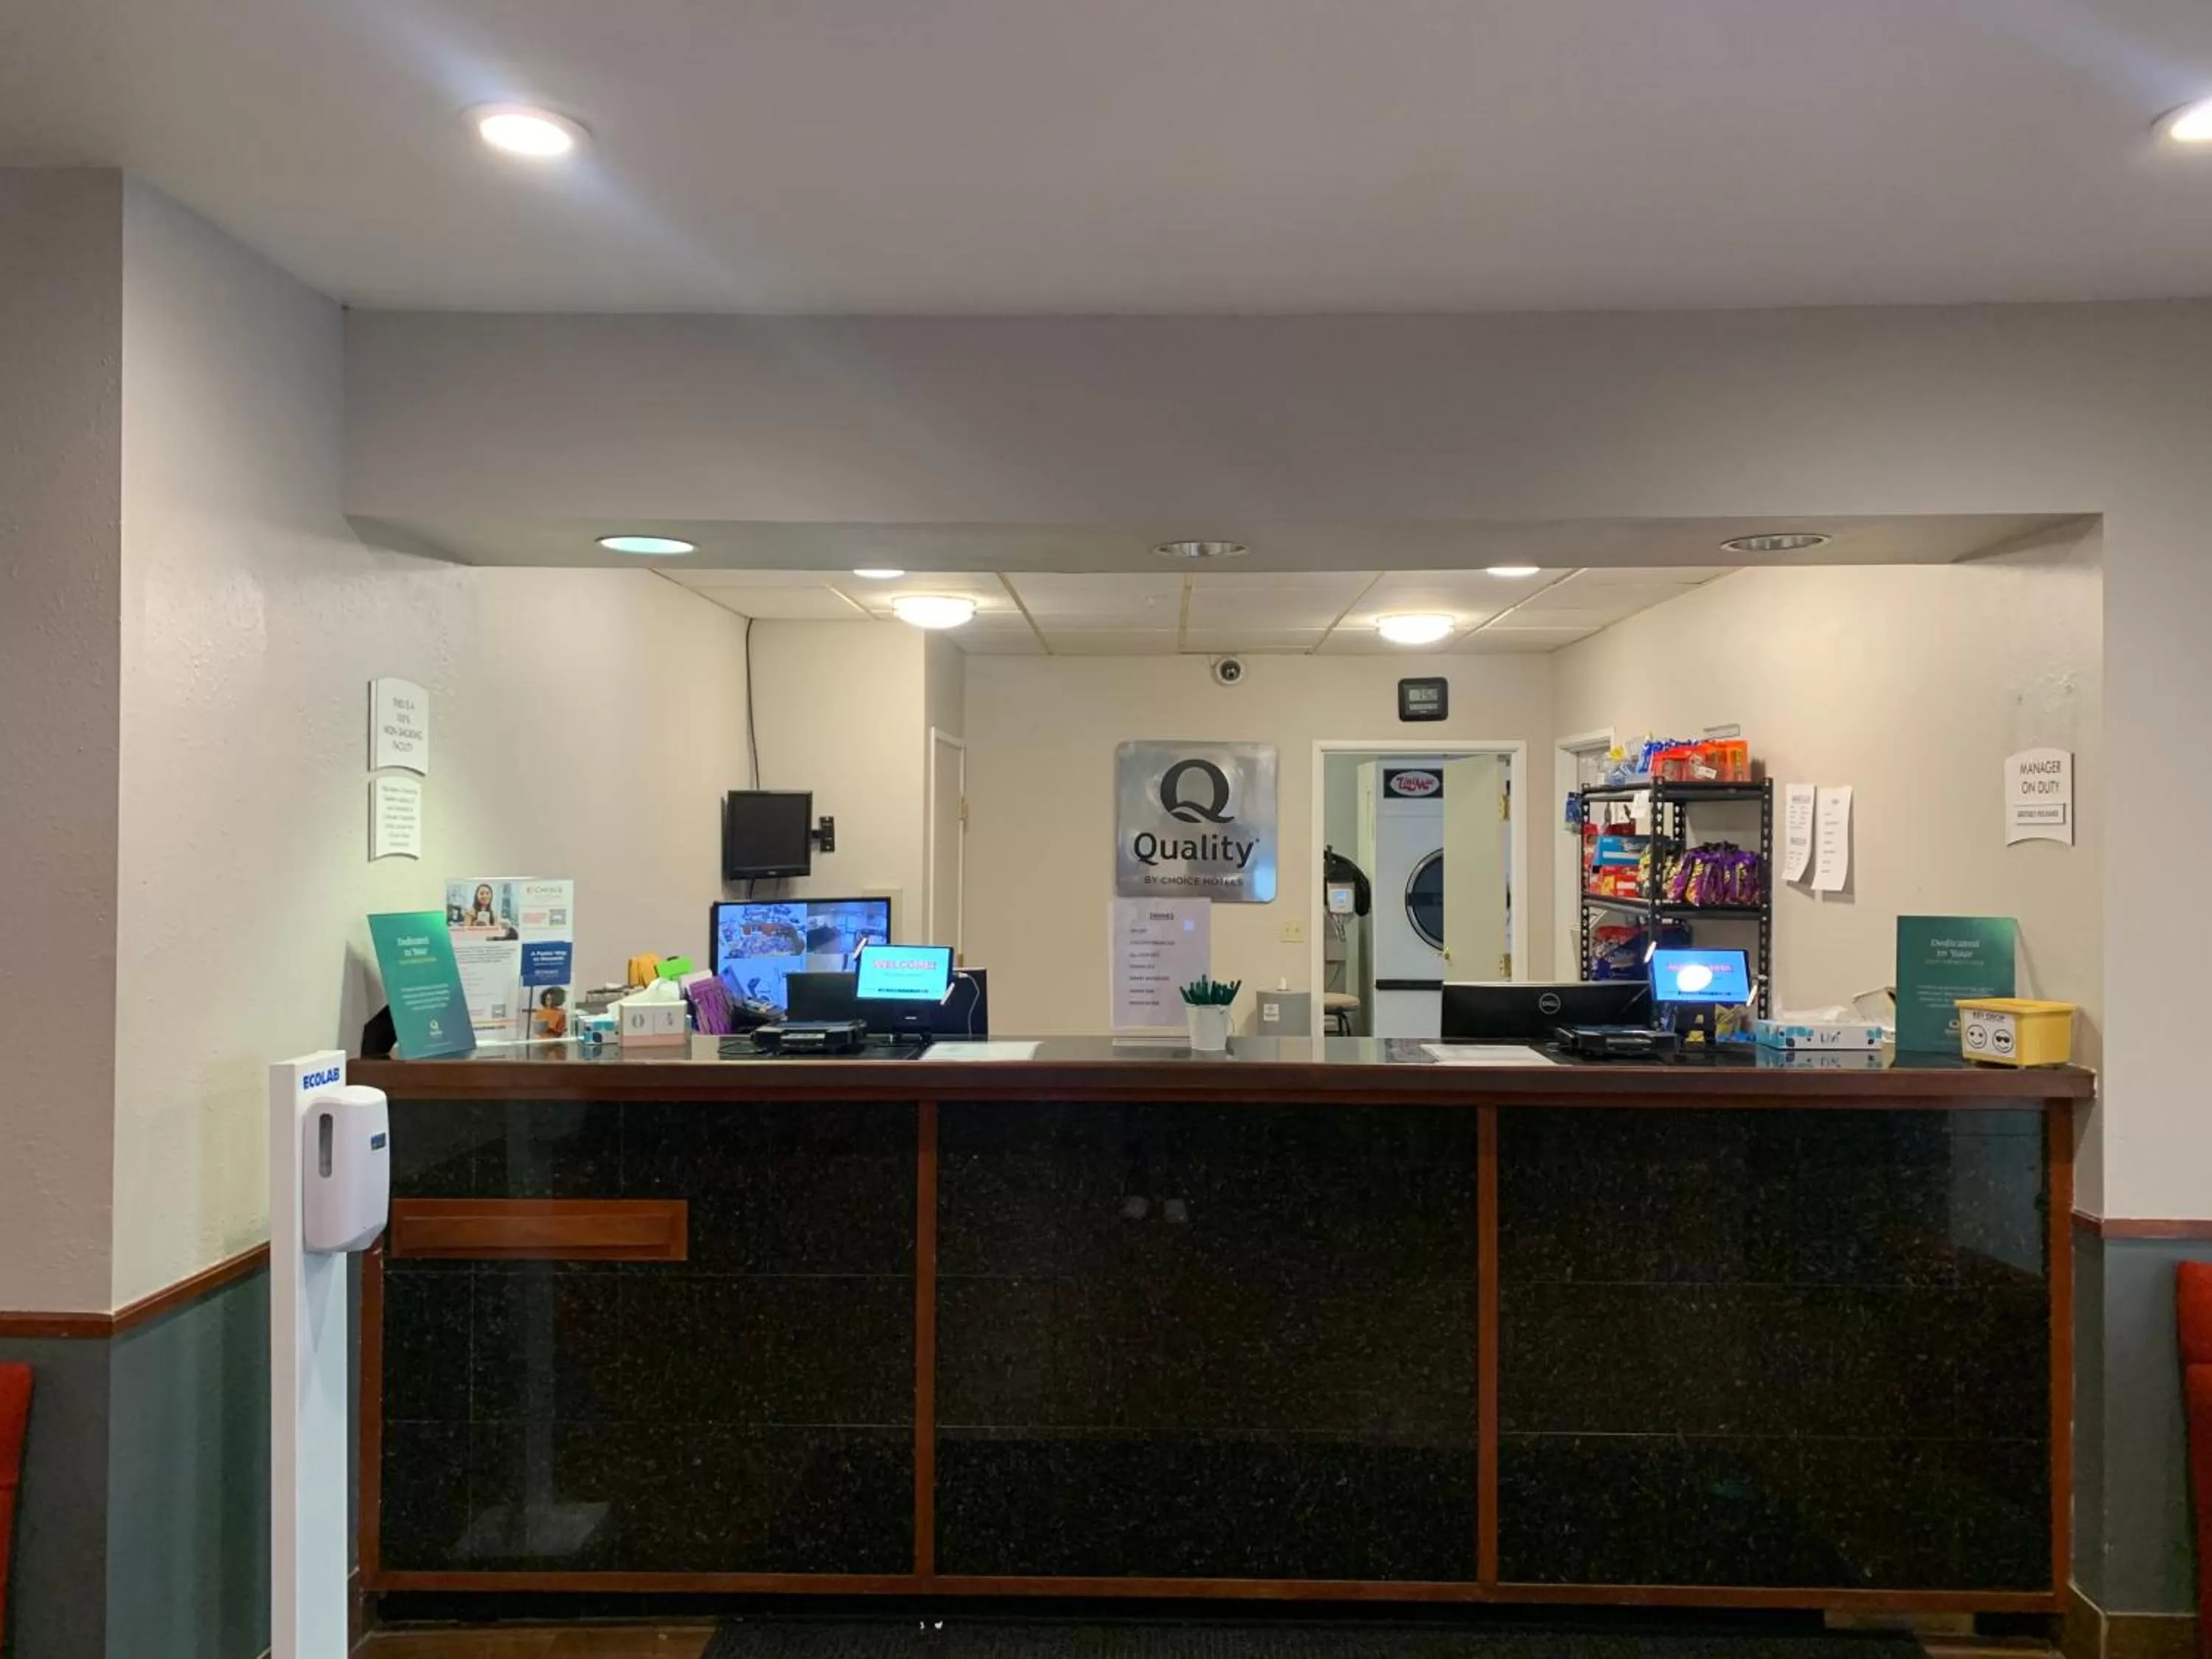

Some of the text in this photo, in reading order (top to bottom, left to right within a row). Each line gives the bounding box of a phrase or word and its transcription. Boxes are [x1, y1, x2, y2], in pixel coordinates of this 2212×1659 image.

[2020, 761, 2061, 774] MANAGER
[1161, 759, 1235, 823] Q
[2021, 780, 2060, 794] ON DUTY
[1133, 832, 1254, 869] Quality
[1144, 875, 1244, 887] BY CHOICE HOTELS
[1930, 939, 1980, 947] Dedicated
[873, 960, 937, 970] WELCOME!
[303, 1067, 341, 1091] ECOLAB
